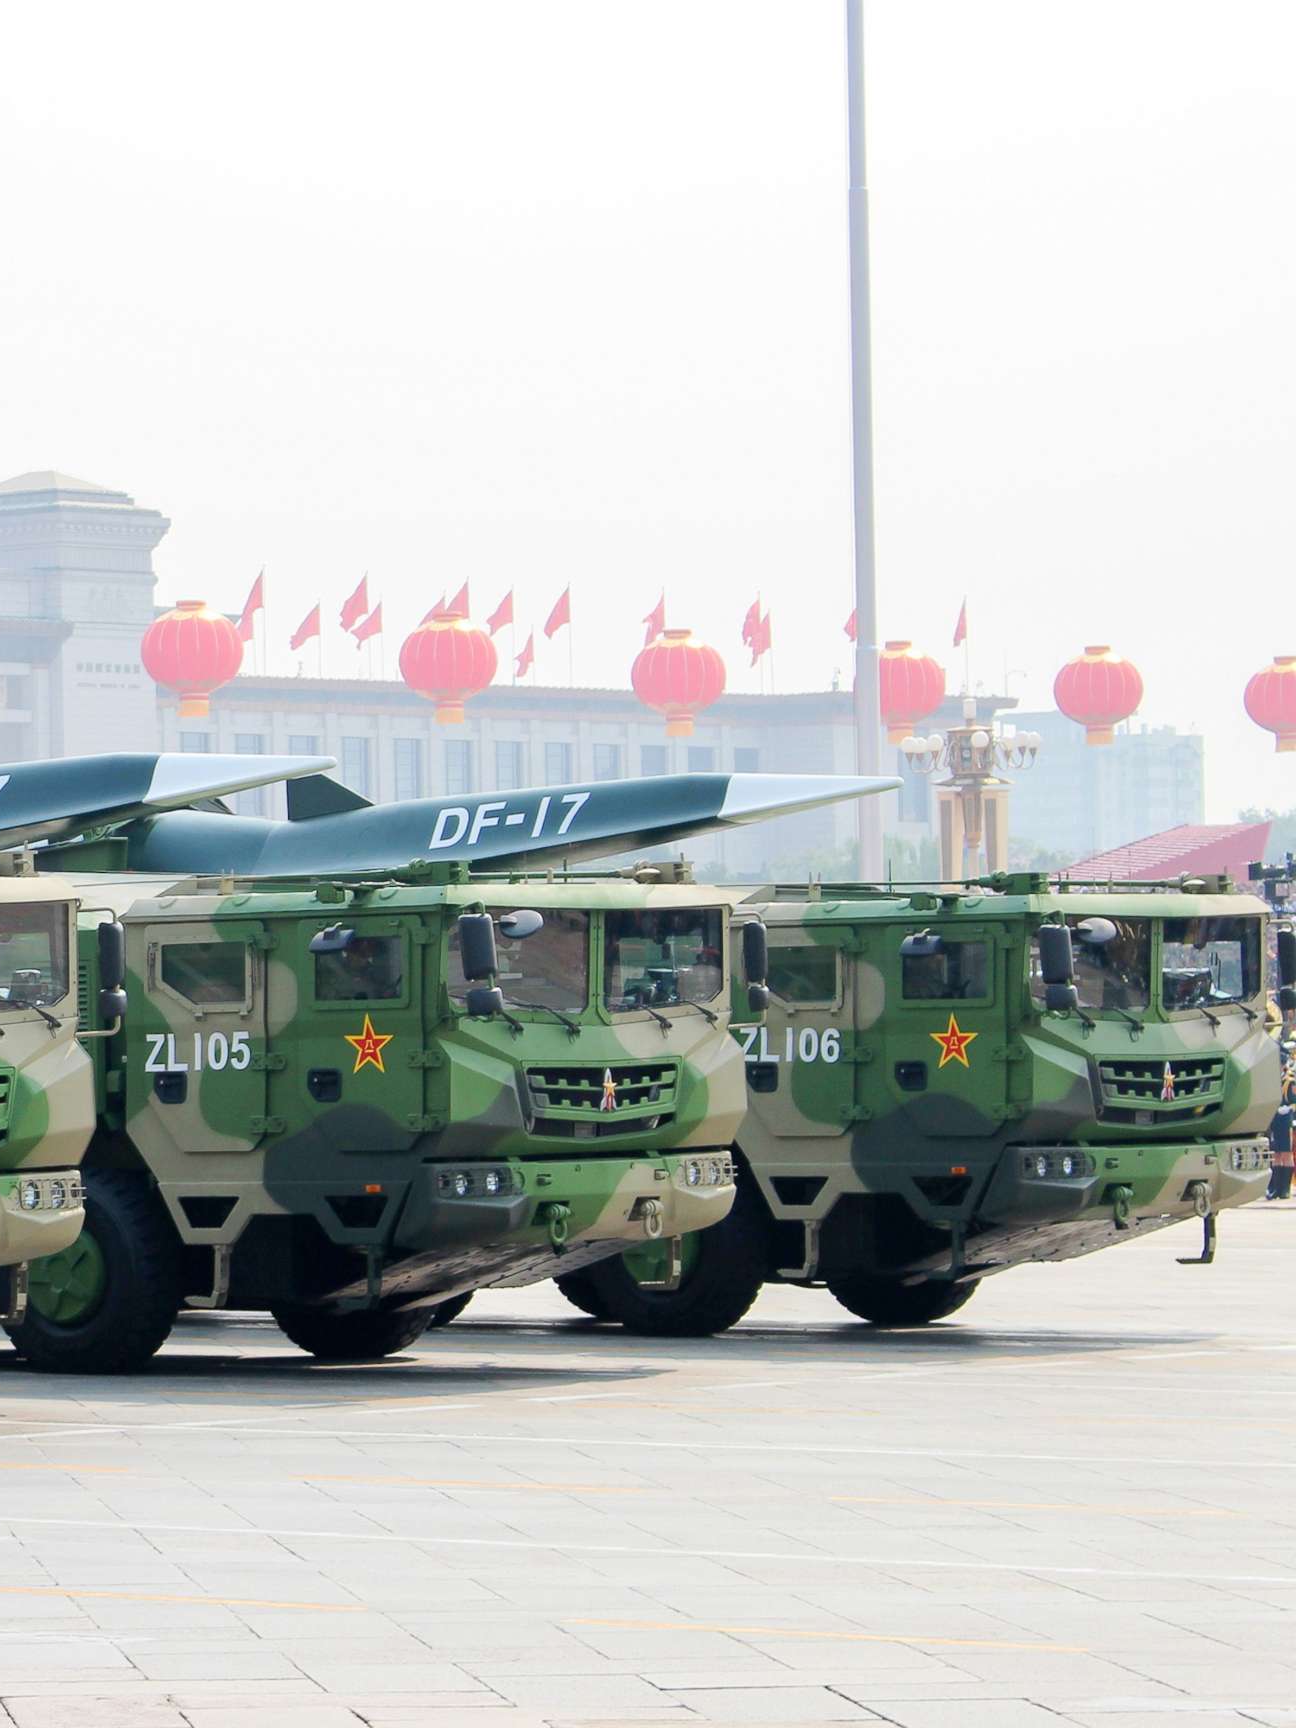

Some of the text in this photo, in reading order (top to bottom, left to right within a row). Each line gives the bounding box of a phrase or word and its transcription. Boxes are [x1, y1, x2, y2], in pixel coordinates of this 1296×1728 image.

[428, 792, 591, 849] DF-17
[144, 1031, 251, 1072] ZL105
[739, 1026, 841, 1063] ZL106
